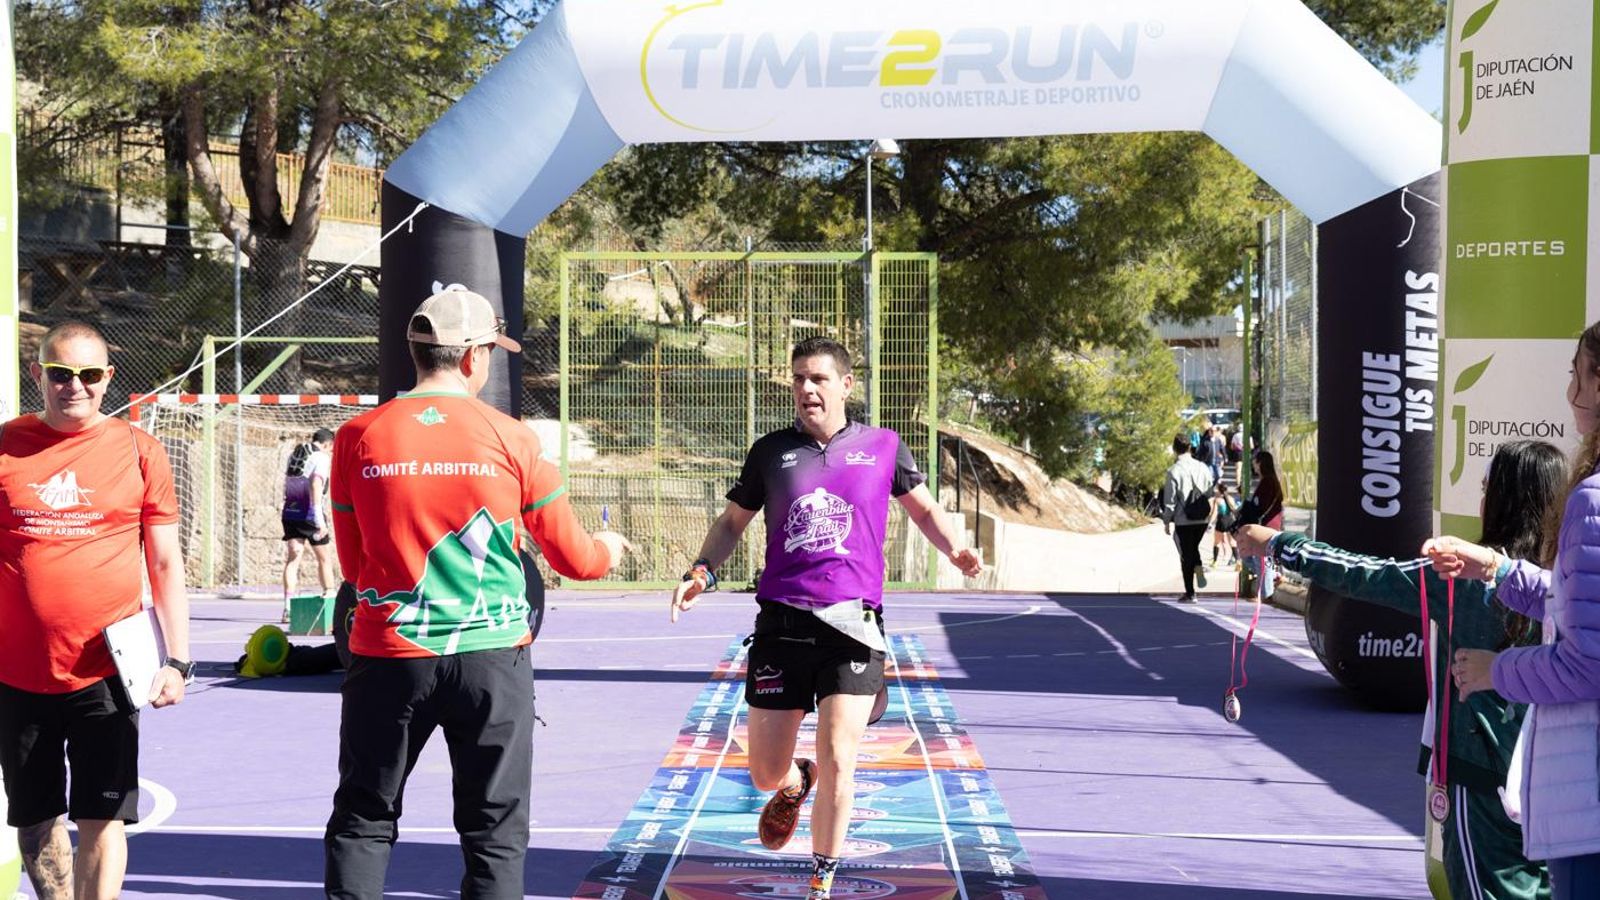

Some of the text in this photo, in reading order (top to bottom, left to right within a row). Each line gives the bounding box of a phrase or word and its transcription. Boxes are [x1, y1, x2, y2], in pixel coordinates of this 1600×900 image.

[667, 22, 1138, 90] TIME2RUN
[1476, 53, 1574, 78] DIPUTACIÓN
[880, 84, 1141, 109] CRONOMETRAJE DEPORTIVO
[1476, 79, 1535, 100] DE JAÉN
[1456, 240, 1565, 258] DEPORTES
[1404, 270, 1440, 432] TUS METAS
[1361, 351, 1401, 518] CONSIGUE
[1468, 419, 1564, 437] DIPUTACIÓN
[1468, 442, 1485, 456] DE
[362, 460, 498, 478] COMITÉ ARBITRAL
[1359, 631, 1424, 657] time2r
